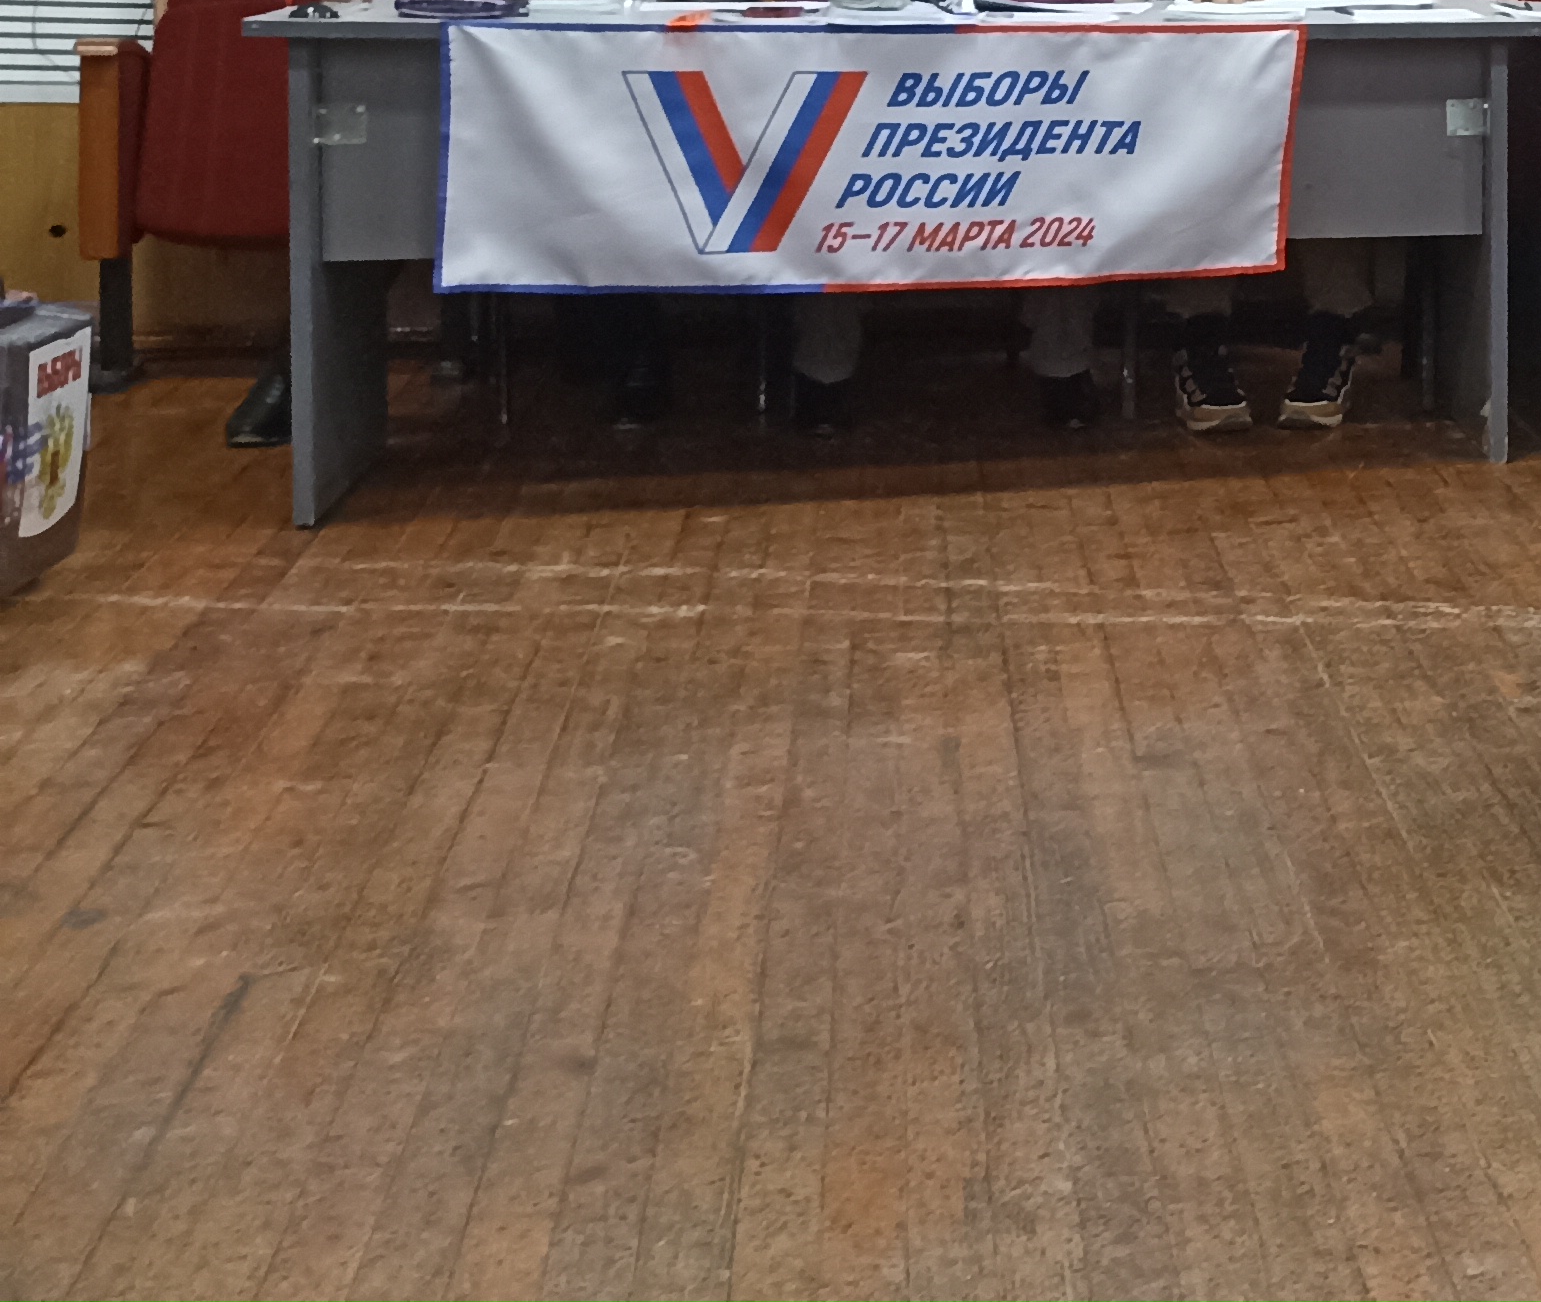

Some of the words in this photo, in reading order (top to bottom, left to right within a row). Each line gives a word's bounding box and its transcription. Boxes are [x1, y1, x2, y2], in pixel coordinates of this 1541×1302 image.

[886, 69, 1090, 108] ВЫБОРЫ
[861, 119, 1142, 162] ПРЕЗИДЕНТА
[835, 170, 1022, 209] РОССИИ
[906, 219, 1018, 252] МАРТА
[1019, 216, 1097, 249] 2024
